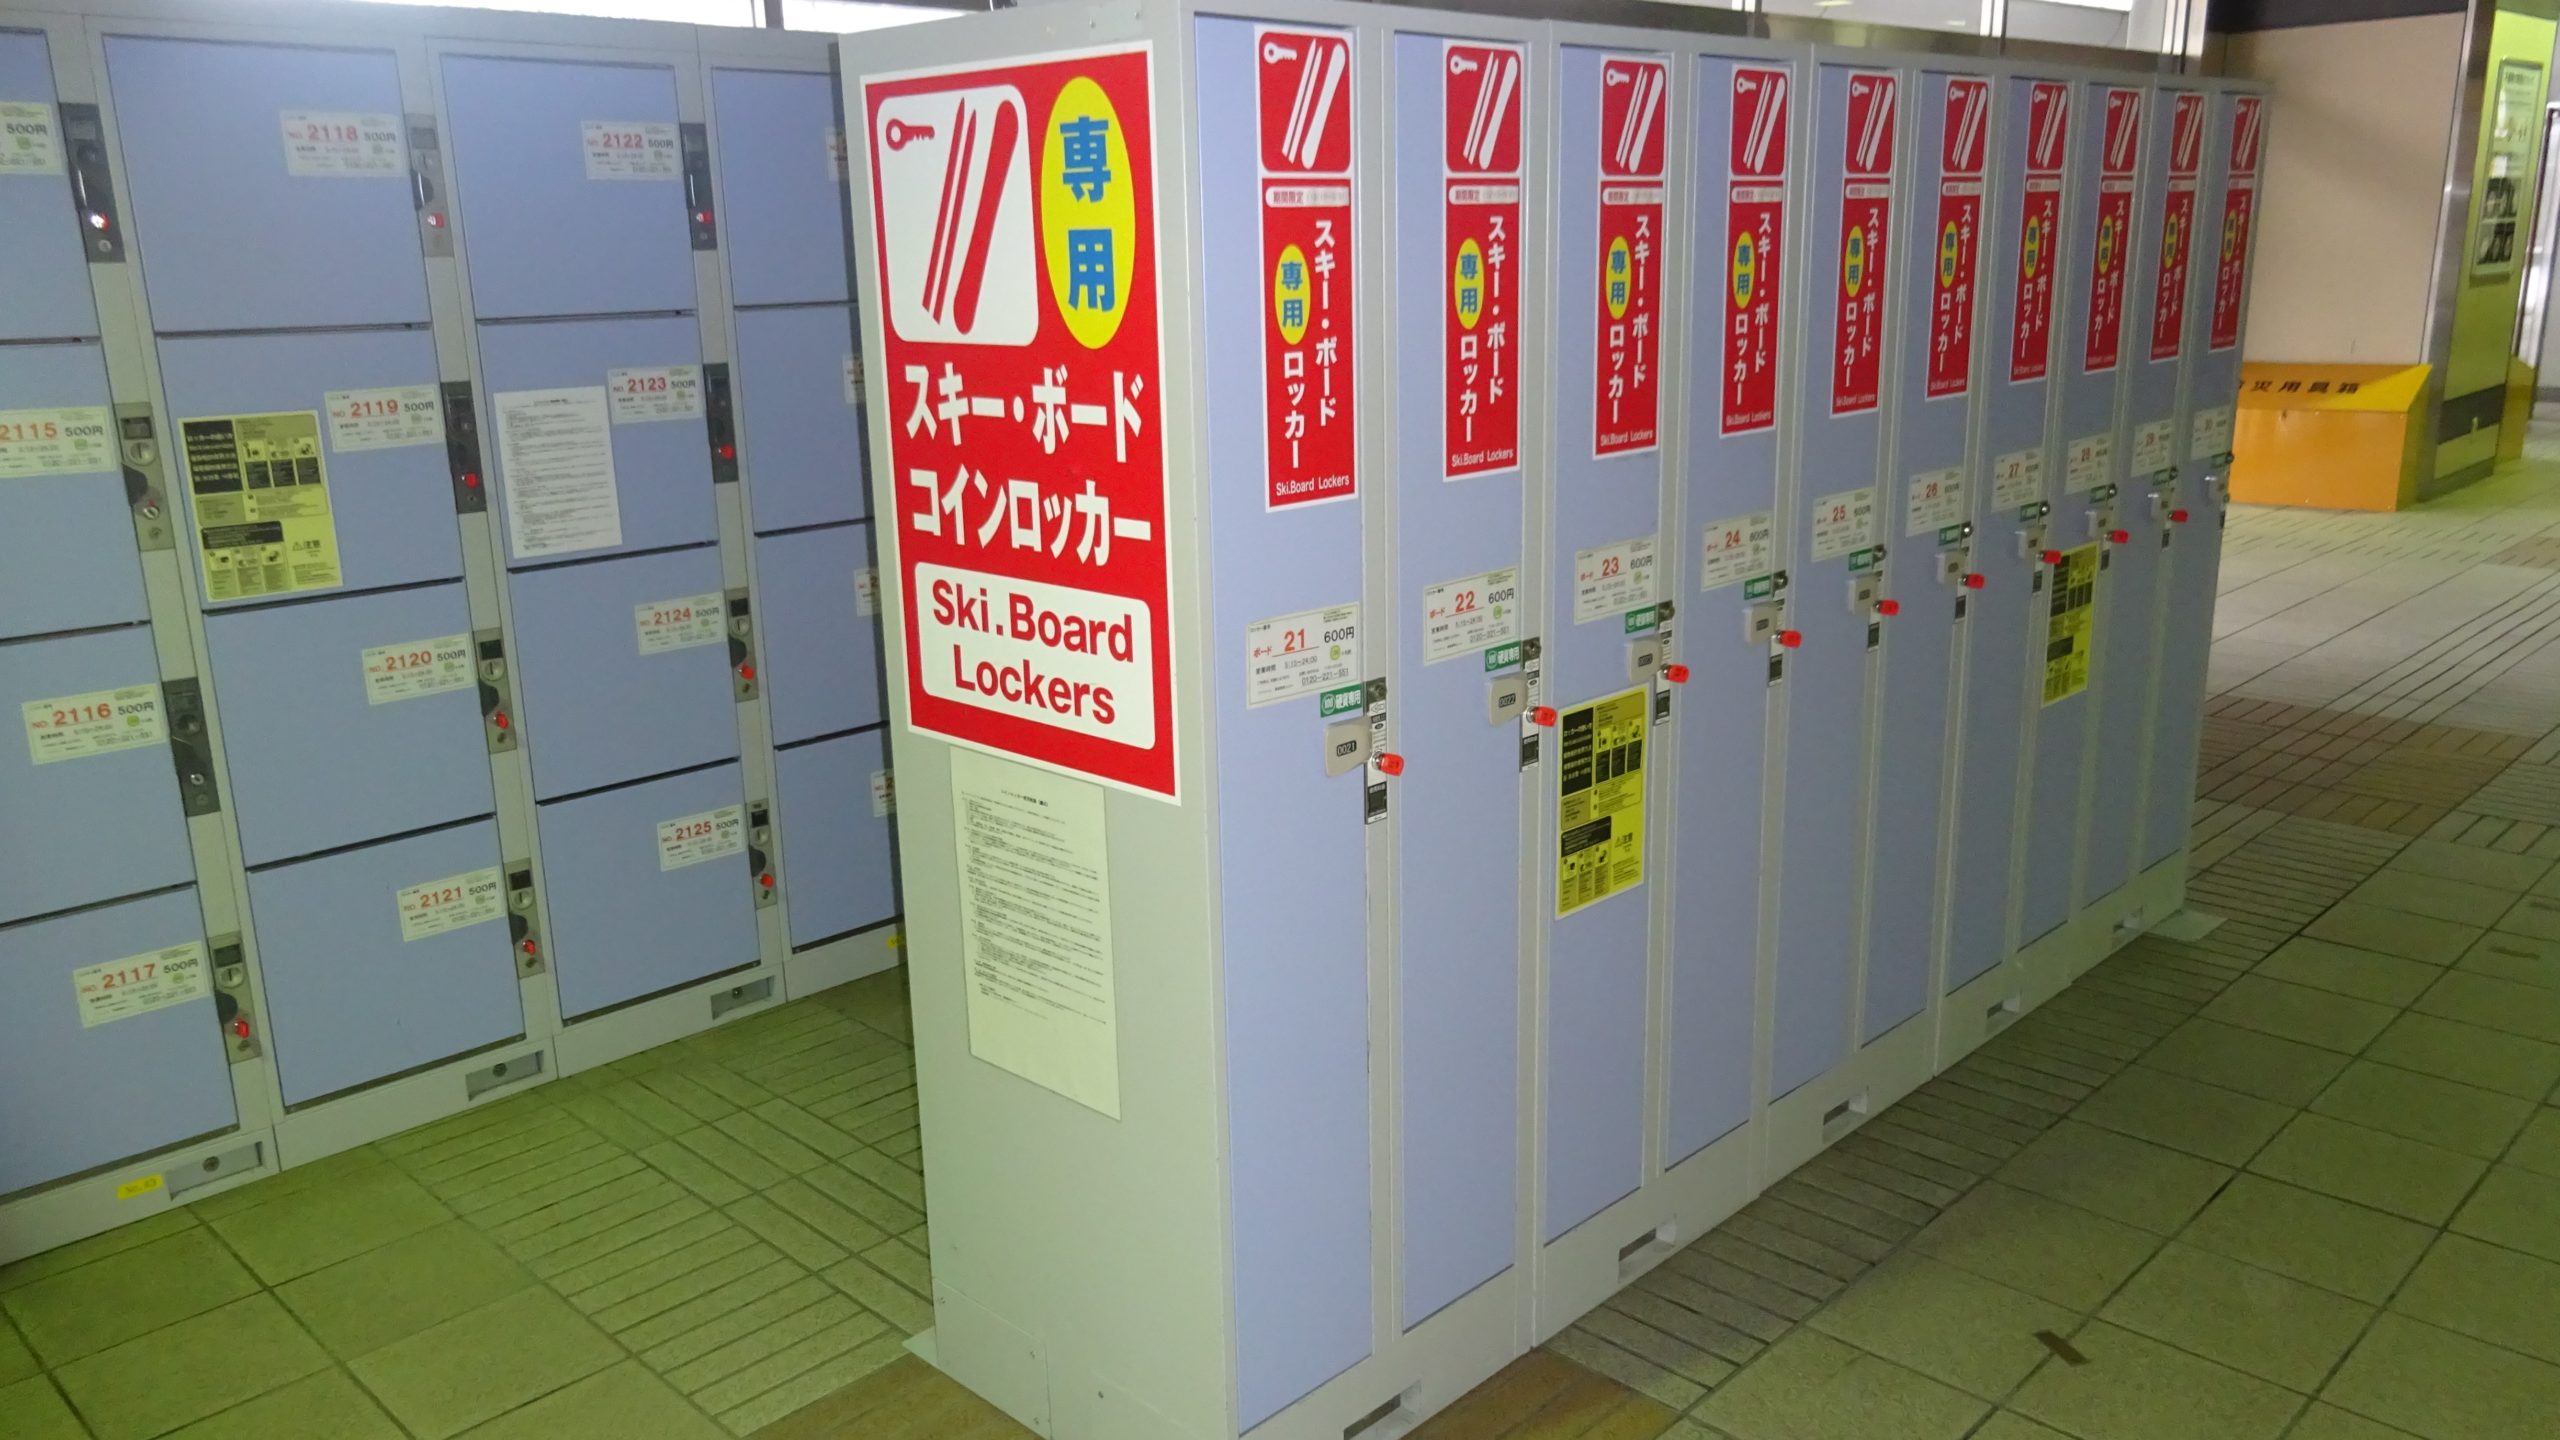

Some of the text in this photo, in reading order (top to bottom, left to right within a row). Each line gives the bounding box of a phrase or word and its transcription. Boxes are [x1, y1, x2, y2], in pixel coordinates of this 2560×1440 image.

[6, 123, 48, 136] 500円
[307, 123, 358, 142] 2118
[602, 132, 644, 149] 2122
[1059, 115, 1115, 312] 専用
[1281, 261, 1303, 328] 専用
[1460, 253, 1478, 314] 専用
[1755, 212, 1771, 373] スキー・ボード
[1862, 208, 1879, 357] スキー・ボード
[1487, 216, 1506, 404] スキー・ボード
[1632, 215, 1650, 388] スキー・ボード
[1314, 220, 1338, 427] スキー・ボード
[1938, 293, 1951, 373] ロッカー
[1733, 313, 1748, 406] ロッカー
[1843, 302, 1857, 387] ロッカー
[627, 376, 667, 393] 2123
[670, 379, 696, 390] 500円
[1460, 335, 1478, 442] ロッカー
[1608, 325, 1624, 424] ロッカー
[2240, 380, 2361, 394] 災用具箱
[350, 399, 399, 417] 2119
[404, 401, 434, 413] 500円
[905, 362, 1144, 463] スキー・ボード
[1284, 351, 1305, 469] ロッカー
[0, 421, 104, 440] 2115 500円
[1276, 474, 1349, 496] Ski.Board Lockers
[910, 463, 1151, 566] コインロッカー
[1832, 504, 1846, 523] 25
[1725, 529, 1741, 548] 24
[1602, 556, 1619, 577] 23
[1630, 555, 1653, 570] 600円
[654, 607, 691, 625] 2124
[1455, 591, 1475, 613] 22
[1488, 588, 1514, 604] 600円
[932, 579, 1133, 663] Ski.Board
[1253, 626, 1355, 658] ボード 21 600円
[385, 650, 432, 672] 2120
[436, 649, 467, 662] 500円
[953, 643, 1115, 725] Lockers
[52, 703, 112, 727] 2116
[117, 701, 154, 716] 500円
[1337, 741, 1355, 755] 0021
[675, 821, 712, 841] 2125
[420, 886, 462, 909] 2121
[468, 881, 497, 896] 500円
[102, 963, 156, 989] 2117
[162, 958, 199, 974] 500円
